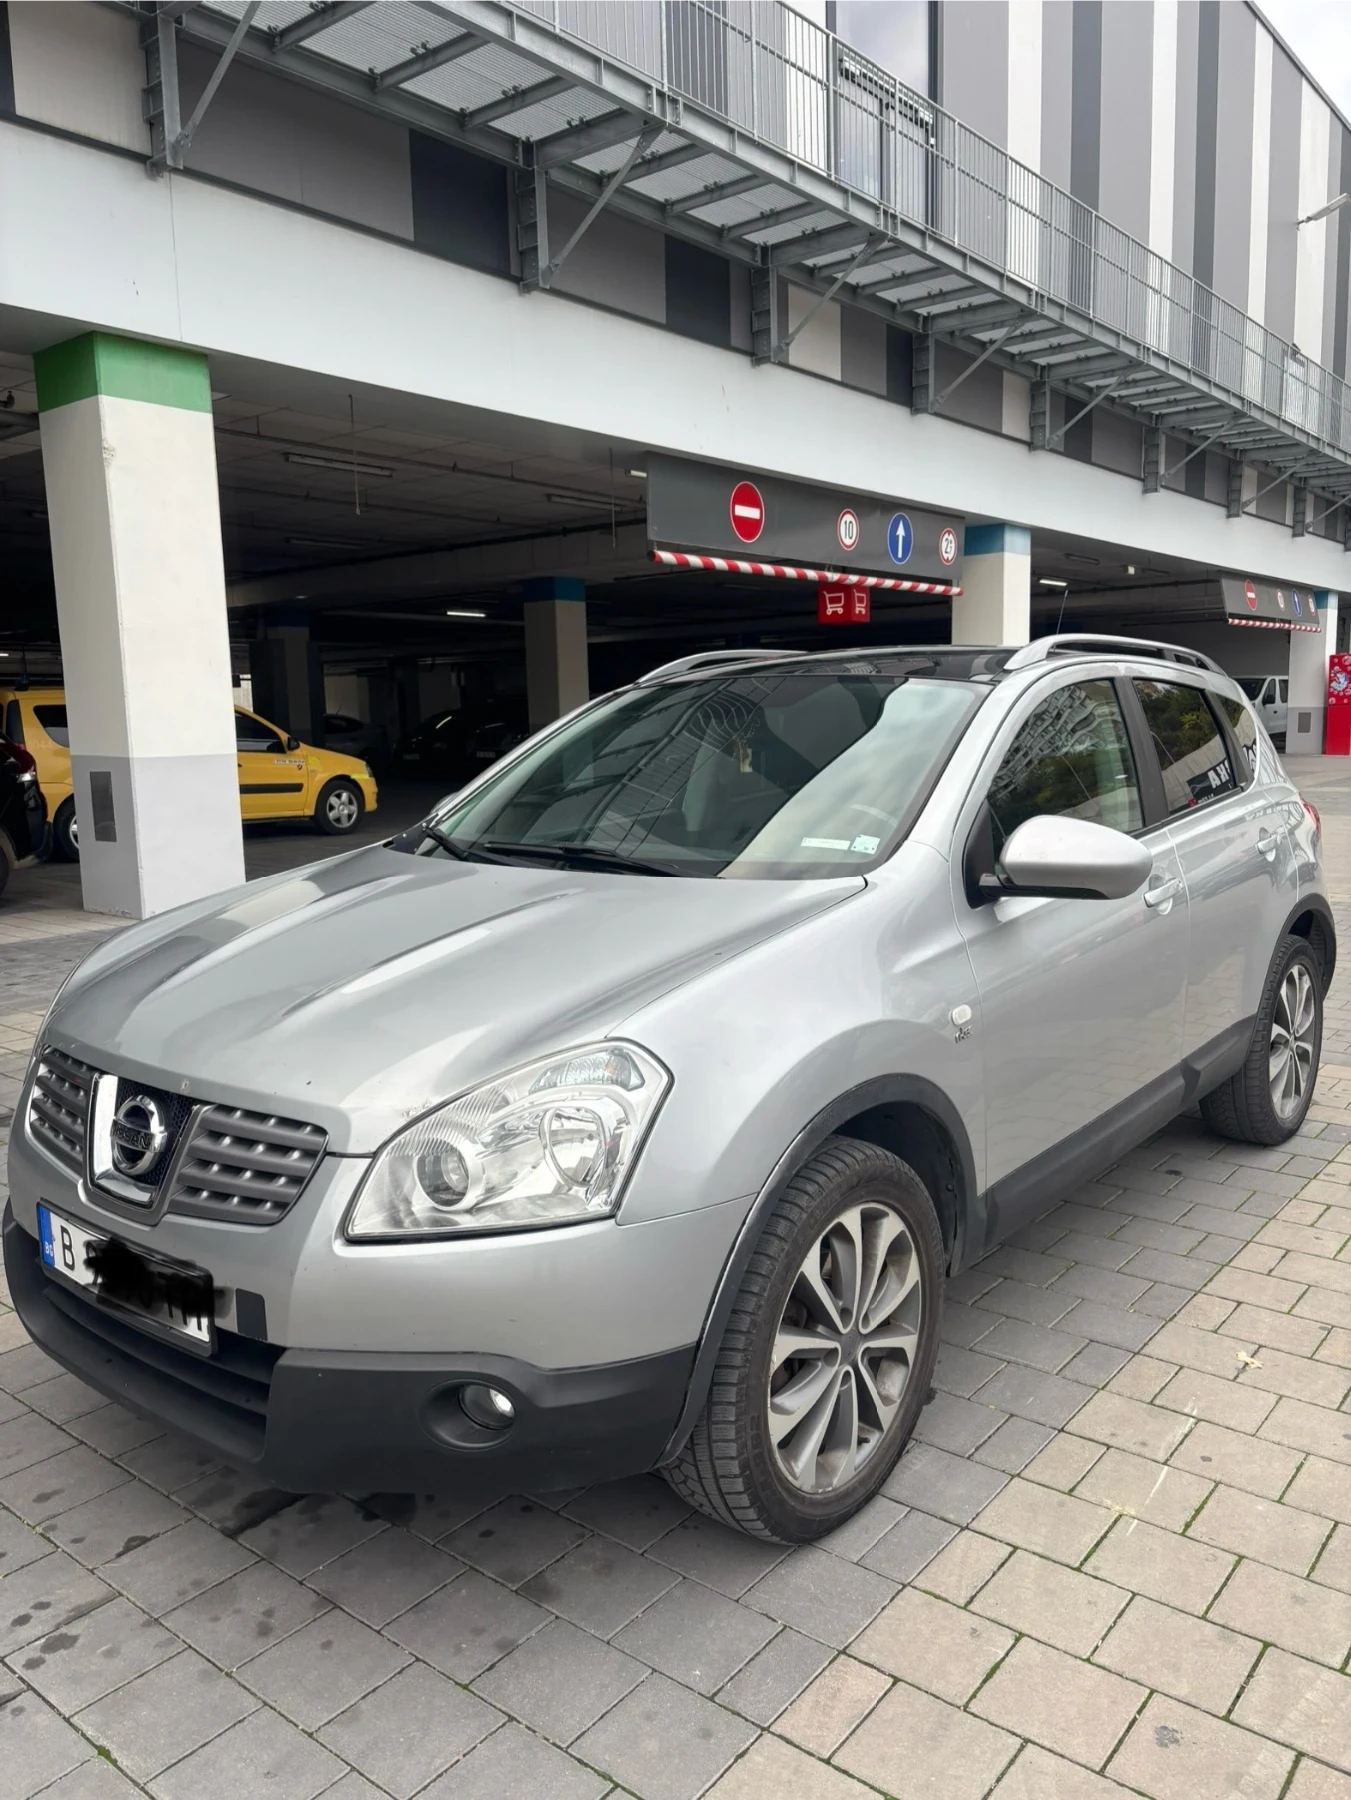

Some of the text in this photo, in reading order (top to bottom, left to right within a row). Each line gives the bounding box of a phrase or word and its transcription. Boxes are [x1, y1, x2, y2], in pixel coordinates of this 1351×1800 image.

[844, 520, 854, 540] 10
[44, 1241, 54, 1257] BG
[60, 1225, 75, 1271] B
